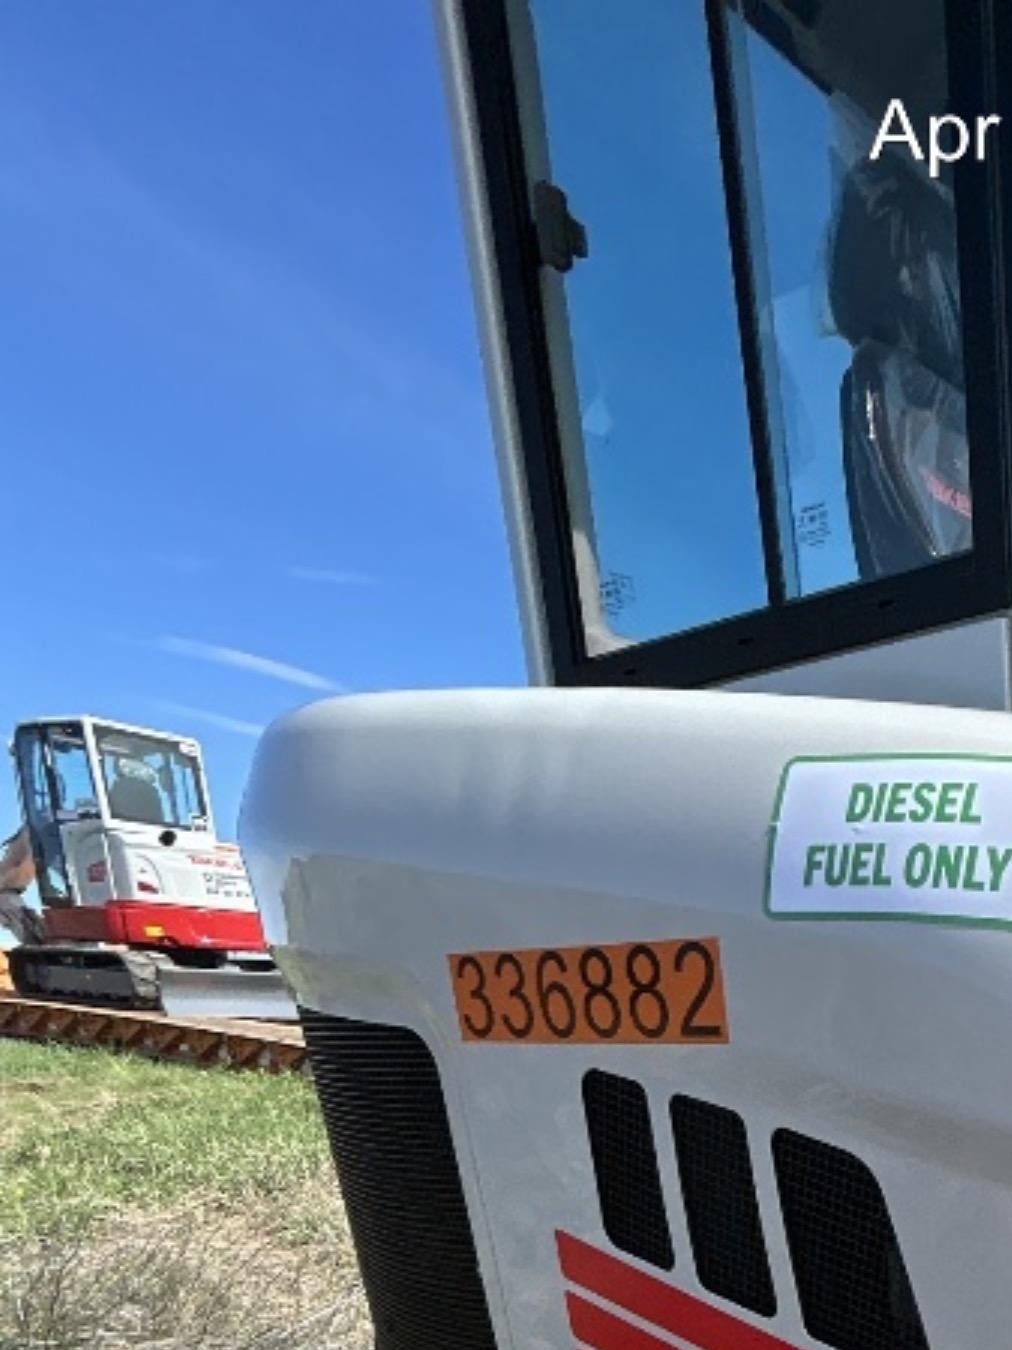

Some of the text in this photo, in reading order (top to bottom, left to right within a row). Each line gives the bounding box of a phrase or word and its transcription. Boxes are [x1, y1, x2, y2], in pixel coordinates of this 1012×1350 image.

[845, 782, 982, 825] DIESEL
[803, 843, 892, 888] FUEL
[456, 940, 723, 1039] 336882
